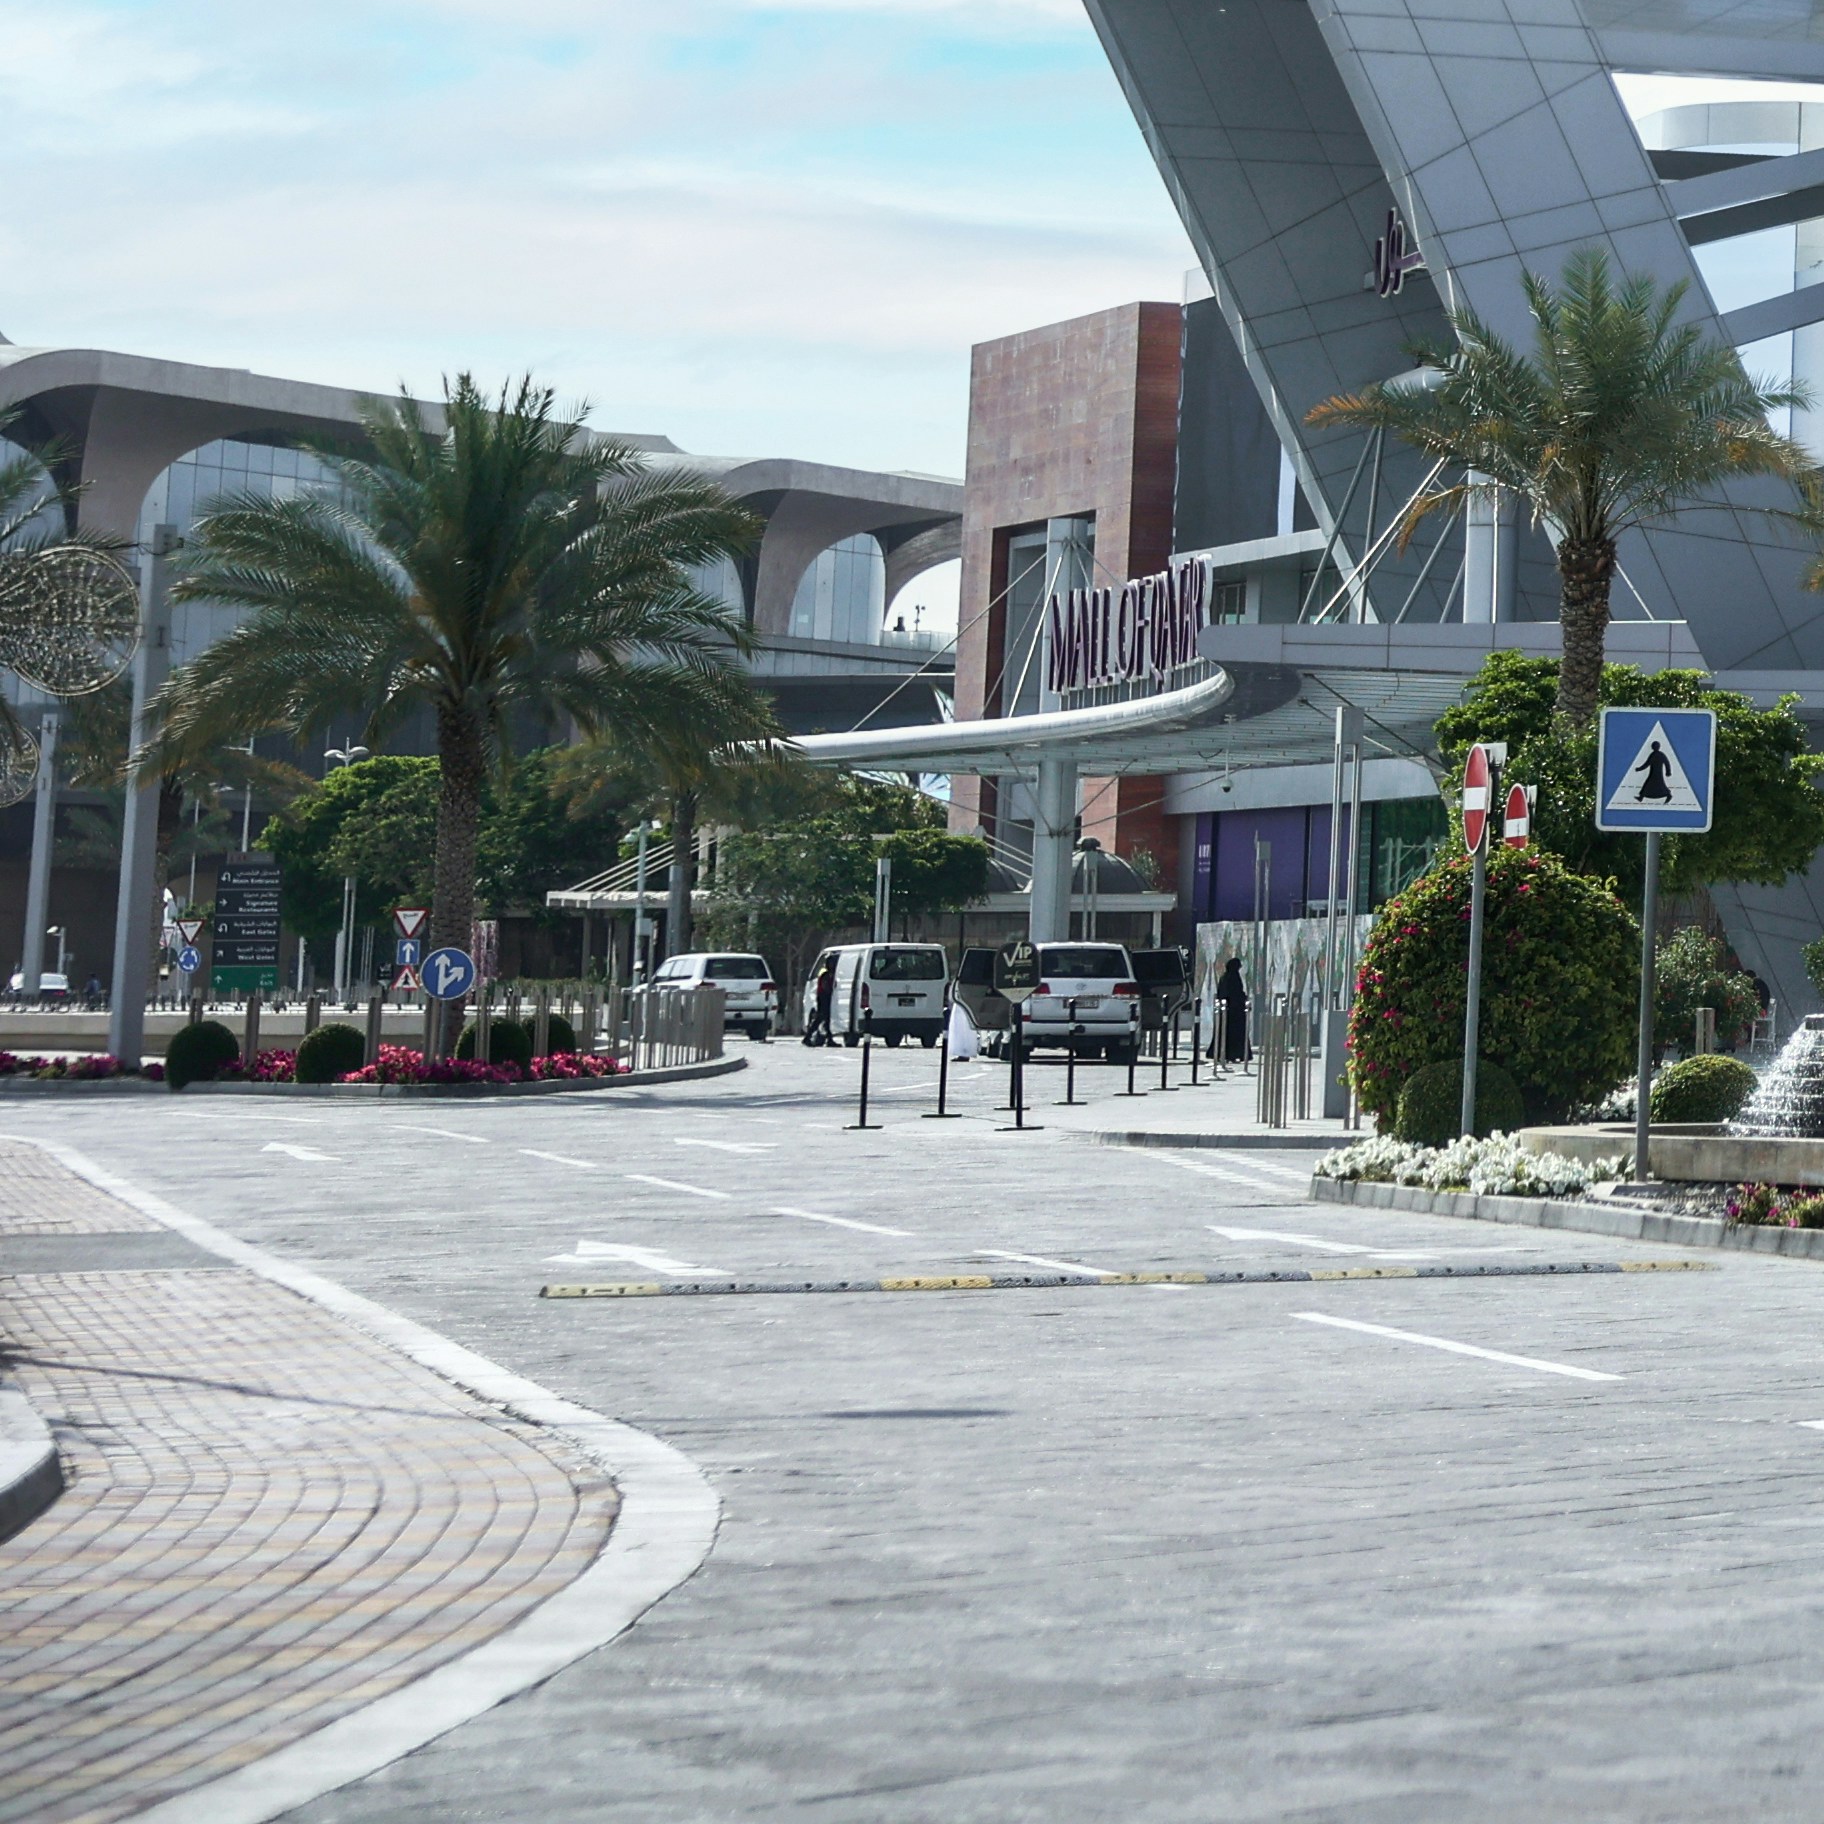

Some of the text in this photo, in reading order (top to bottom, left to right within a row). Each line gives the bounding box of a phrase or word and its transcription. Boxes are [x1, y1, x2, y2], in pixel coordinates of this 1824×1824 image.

[1048, 556, 1208, 695] MALL OF QATAR
